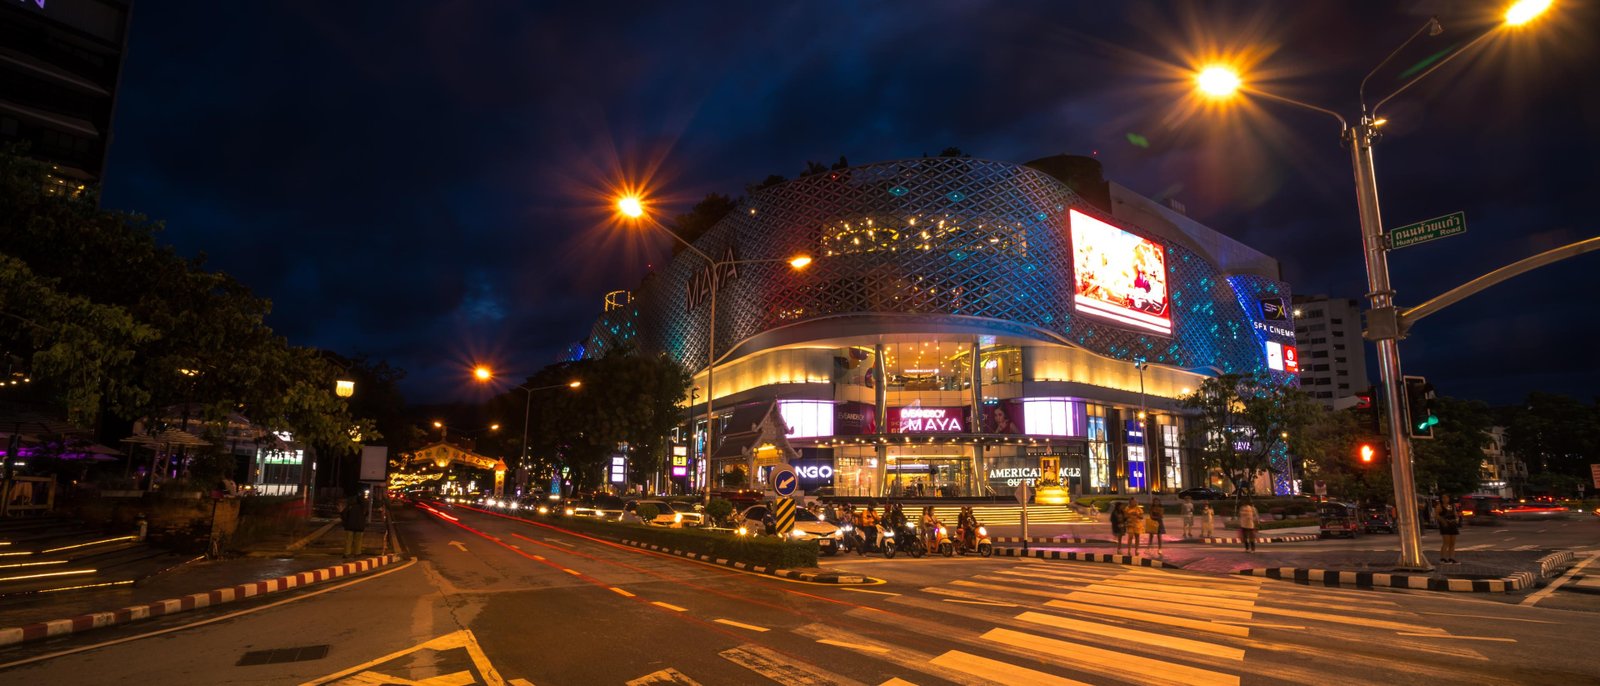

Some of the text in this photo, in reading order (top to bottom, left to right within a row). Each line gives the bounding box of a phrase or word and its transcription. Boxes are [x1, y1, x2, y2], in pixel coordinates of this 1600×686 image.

[1395, 216, 1461, 240] ถนนห้วยแก้ว
[1396, 226, 1461, 247] Huaykaew Road
[685, 247, 737, 312] MAYA
[1264, 302, 1284, 319] SFX
[1253, 321, 1267, 331] SFX
[908, 418, 962, 431] MAYA
[1059, 467, 1081, 477] AGLE
